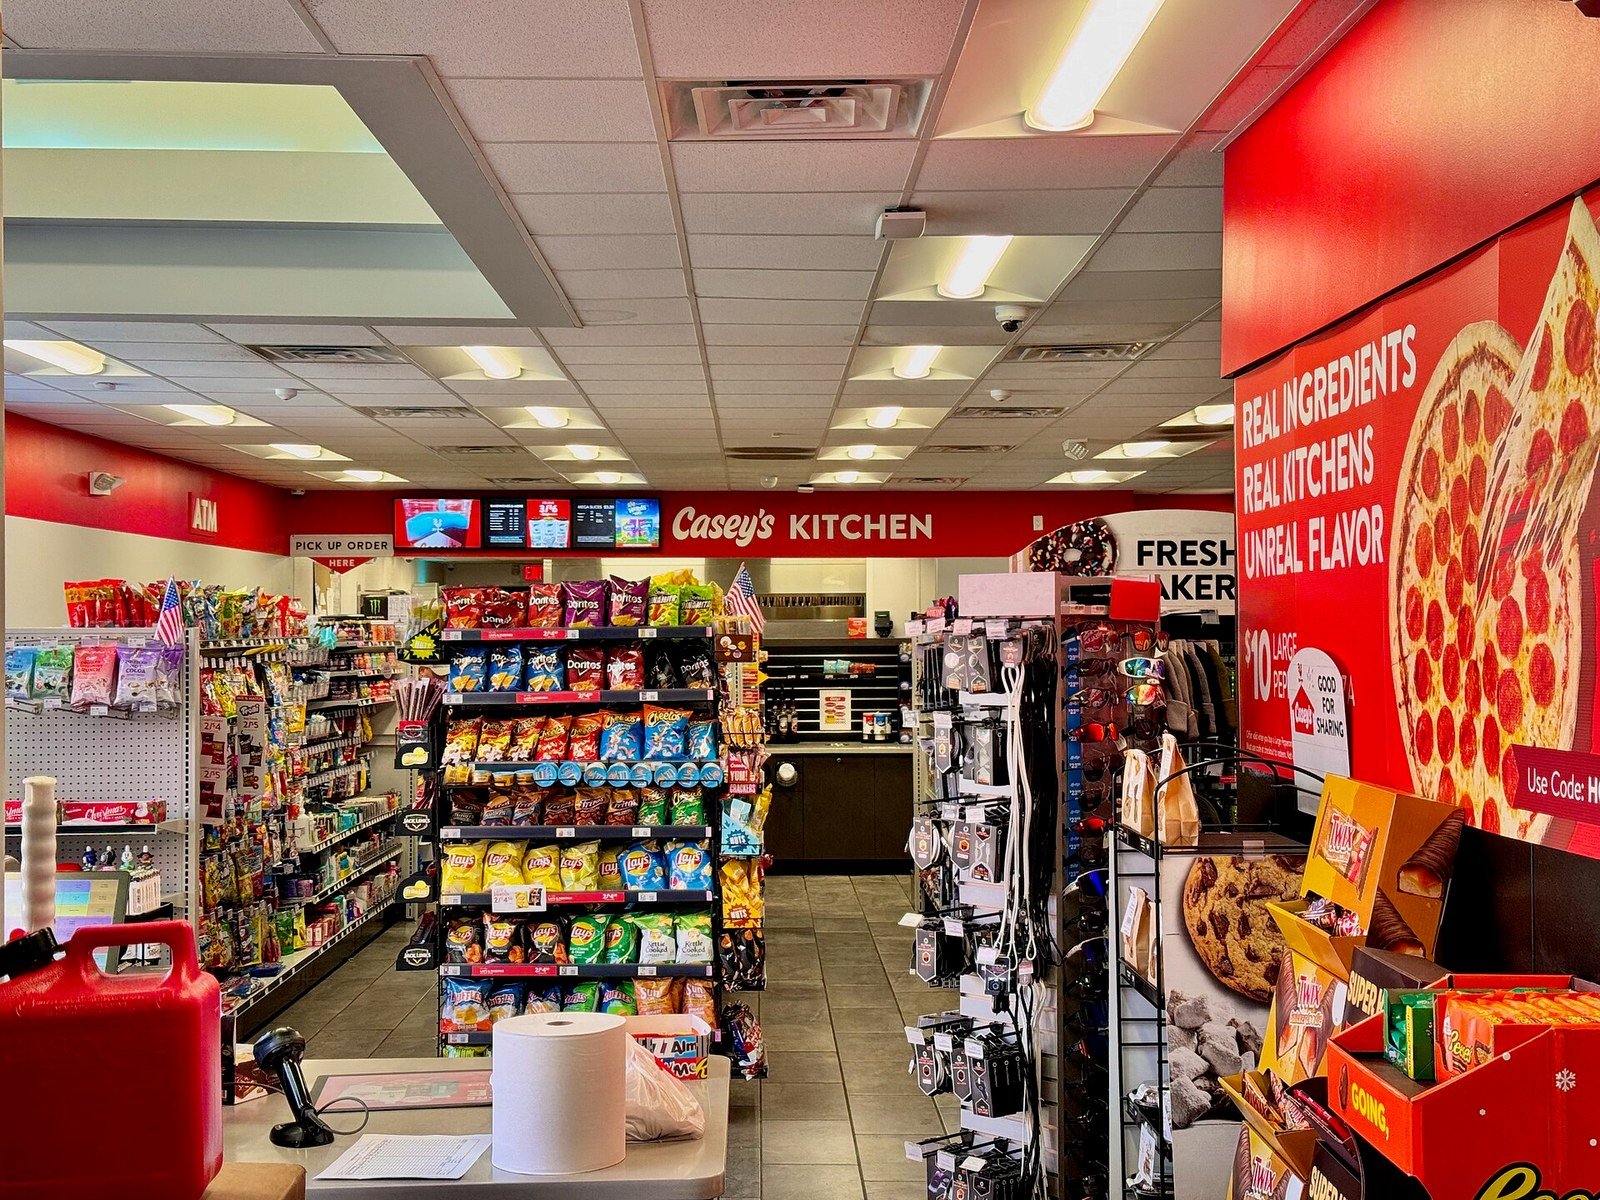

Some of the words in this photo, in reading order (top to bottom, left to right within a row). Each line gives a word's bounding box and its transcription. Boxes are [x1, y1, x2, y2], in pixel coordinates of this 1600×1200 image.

[1243, 389, 1280, 449] REAL
[1283, 324, 1416, 433] INGREDIENTS
[1244, 458, 1280, 514] REAL
[1284, 424, 1374, 504] KITCHENS
[192, 498, 218, 532] ATM
[672, 506, 775, 547] Casey's
[790, 514, 932, 539] KITCHEN
[296, 542, 321, 550] PICK
[328, 542, 342, 550] UP
[347, 541, 388, 550] ORDER
[1137, 540, 1235, 566] FRESH
[1245, 522, 1303, 580] UNREAL
[1309, 504, 1383, 572] FLAVOR
[329, 559, 355, 567] HERE
[611, 593, 642, 604] Doritos
[567, 660, 601, 669] Doritos
[1245, 628, 1271, 702] $10
[1272, 632, 1297, 661] LARGE
[1318, 675, 1336, 694] GOOD
[648, 710, 685, 726] Cheetos
[1295, 702, 1313, 729] Casey's
[1322, 697, 1335, 715] FOR
[1316, 717, 1344, 738] SHARING
[730, 771, 748, 781] YUM!
[730, 784, 756, 793] CRACKERS
[1527, 767, 1548, 795] Use
[1551, 771, 1584, 801] Code:
[1588, 776, 1600, 803] H
[1329, 815, 1355, 849] TWIX
[627, 855, 650, 870] Lay's
[677, 852, 701, 865] Lay's
[570, 926, 595, 939] Lay's
[1298, 975, 1322, 1007] TWIX
[1347, 970, 1378, 1016] SUPER
[1351, 1083, 1389, 1140] GOING,
[1252, 1156, 1277, 1195] TWIX
